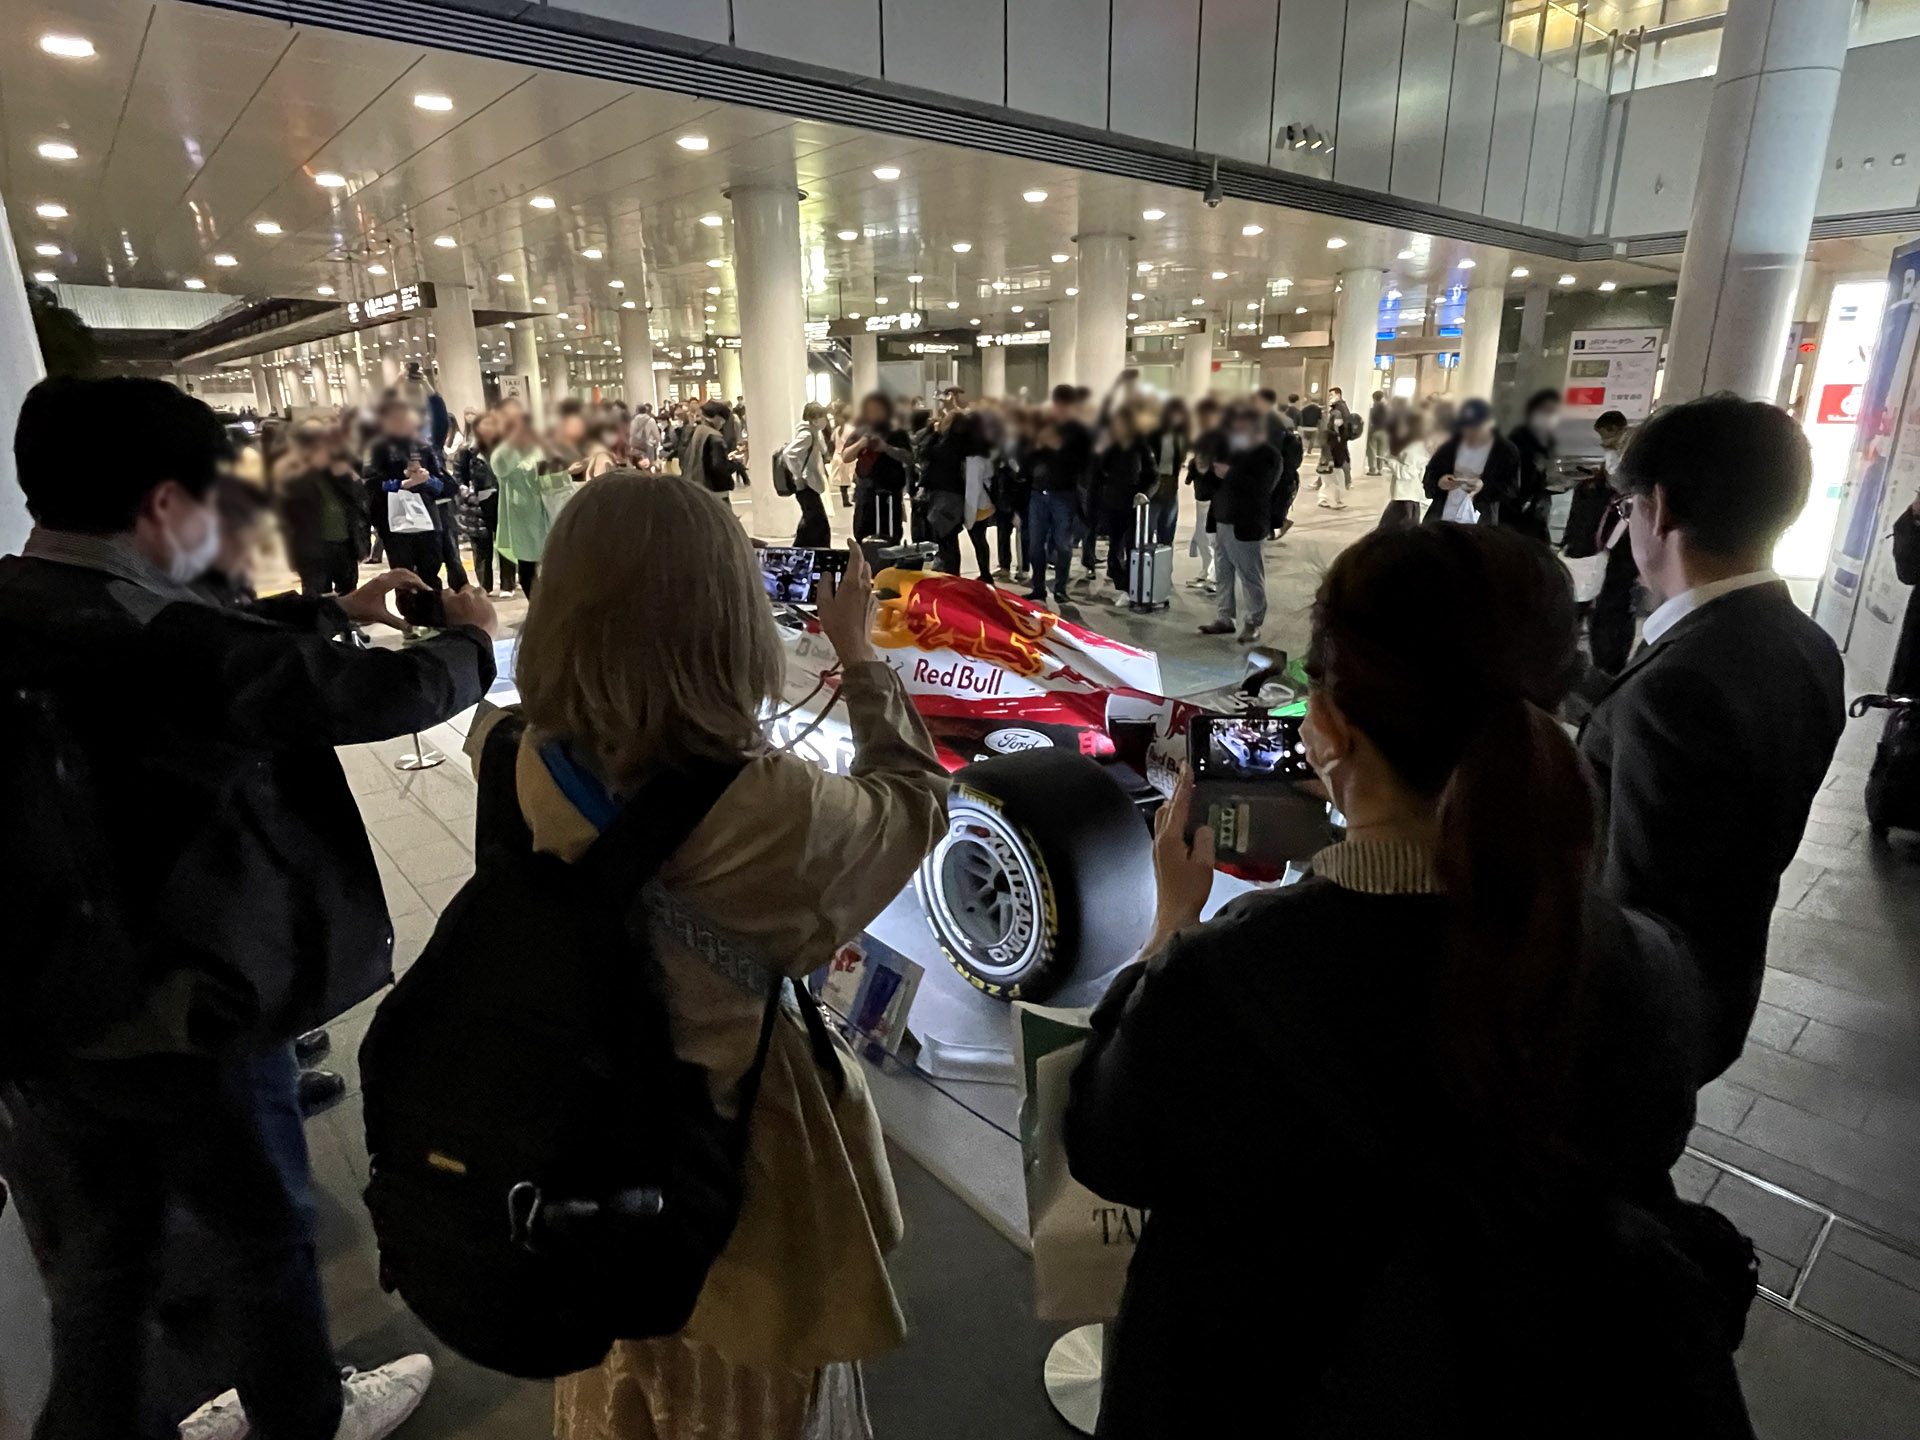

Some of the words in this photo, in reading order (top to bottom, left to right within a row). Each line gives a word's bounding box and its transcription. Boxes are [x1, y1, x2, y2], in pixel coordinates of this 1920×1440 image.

[913, 658, 958, 687] Red
[958, 665, 1004, 696] Bull
[997, 732, 1040, 750] Ford
